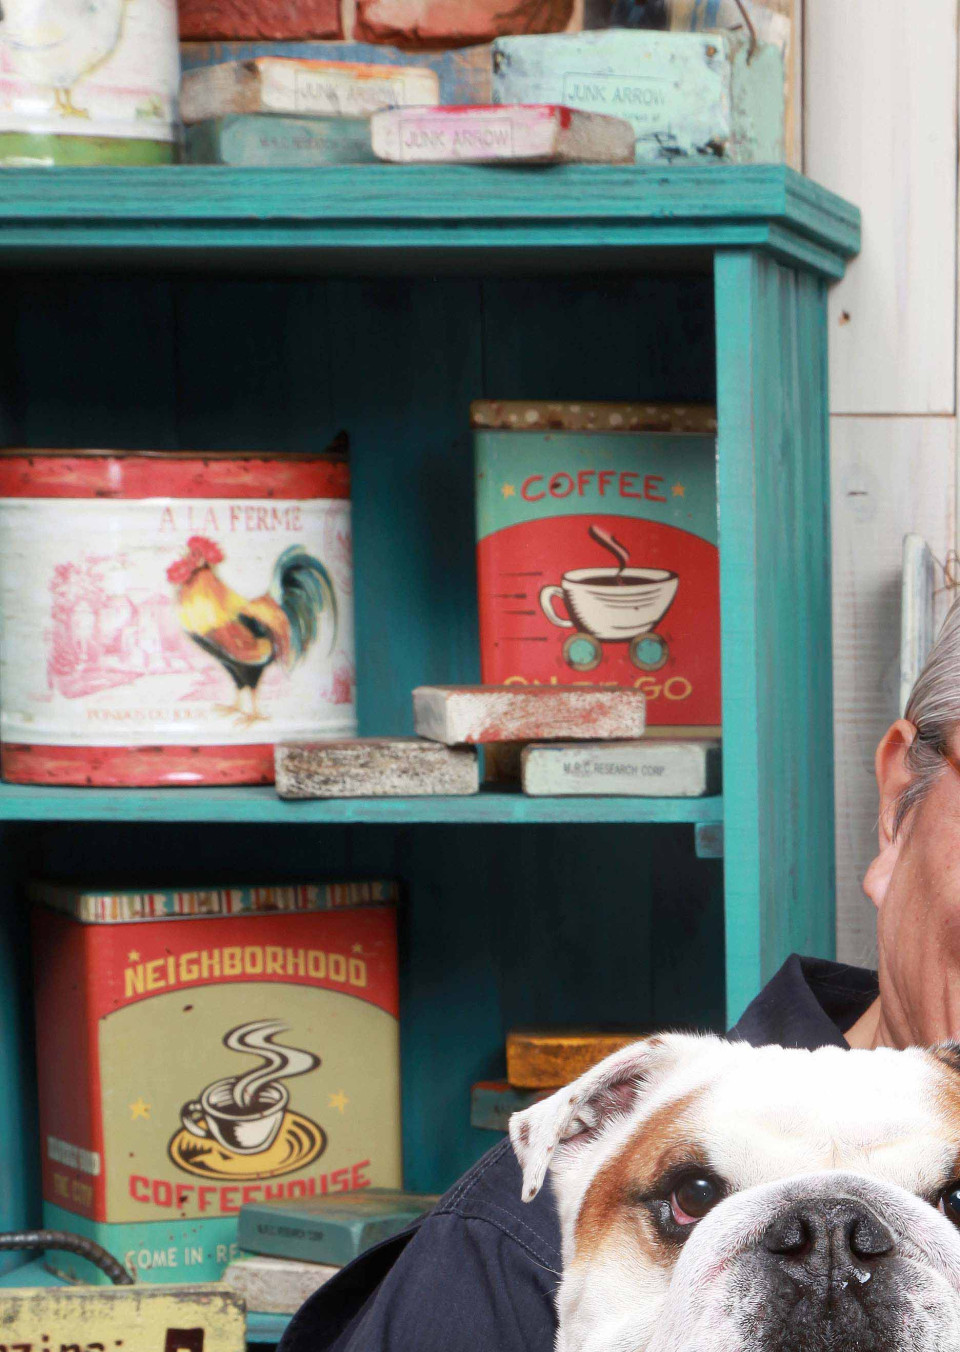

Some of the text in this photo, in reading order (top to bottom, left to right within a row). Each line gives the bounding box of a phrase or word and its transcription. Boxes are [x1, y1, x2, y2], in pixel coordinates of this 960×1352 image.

[567, 84, 606, 101] JUNK
[405, 129, 509, 149] JUNK ARROW
[520, 469, 668, 503] COFFEE
[159, 505, 304, 533] A LA FERME
[633, 675, 693, 701] GO
[124, 946, 367, 998] NEIGHBORHOOD
[128, 1158, 372, 1213] COFFEEHOUSE
[124, 1246, 178, 1271] COME
[184, 1246, 203, 1266] IN
